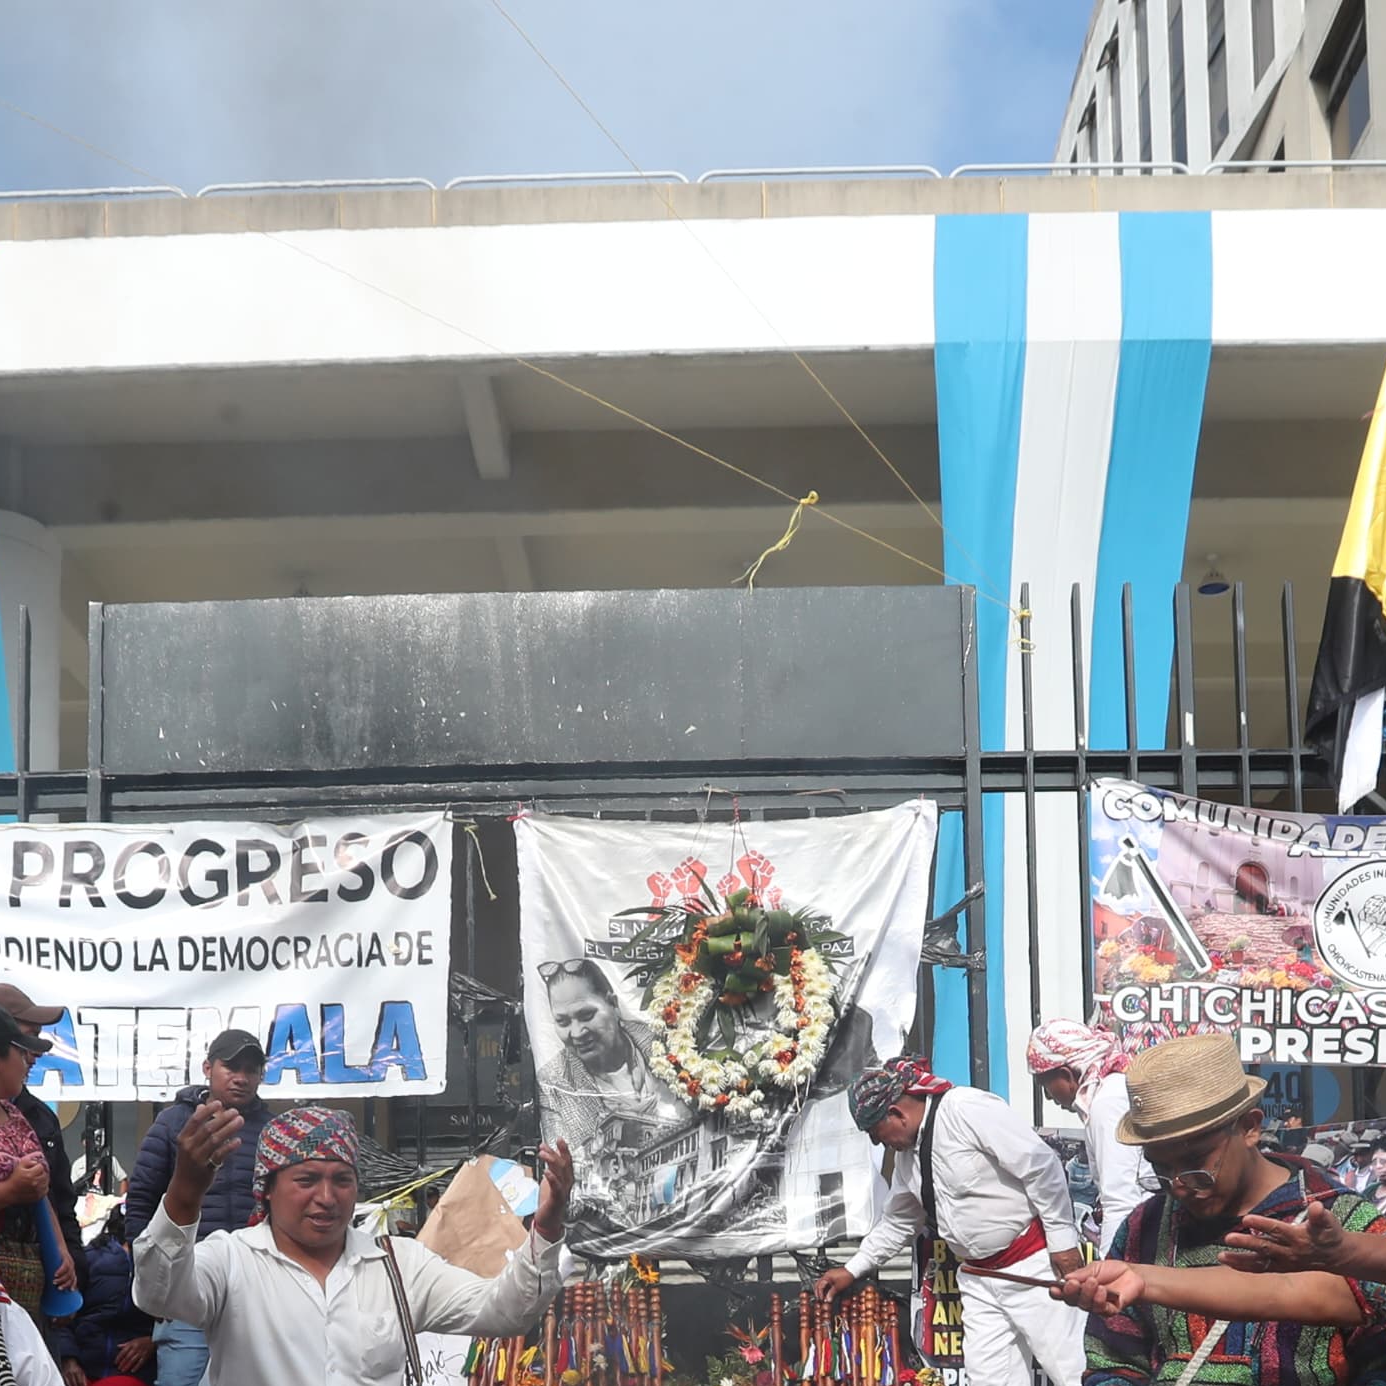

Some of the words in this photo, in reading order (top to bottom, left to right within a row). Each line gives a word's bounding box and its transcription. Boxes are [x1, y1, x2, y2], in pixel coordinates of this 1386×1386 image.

[8, 829, 440, 911] PROGRESO
[1323, 870, 1372, 934] COMUNIDADES
[609, 921, 626, 935] SI
[820, 939, 854, 954] PAZ
[131, 934, 170, 973] LA
[177, 931, 387, 973] DEMOCRACIA
[392, 930, 434, 967] DE
